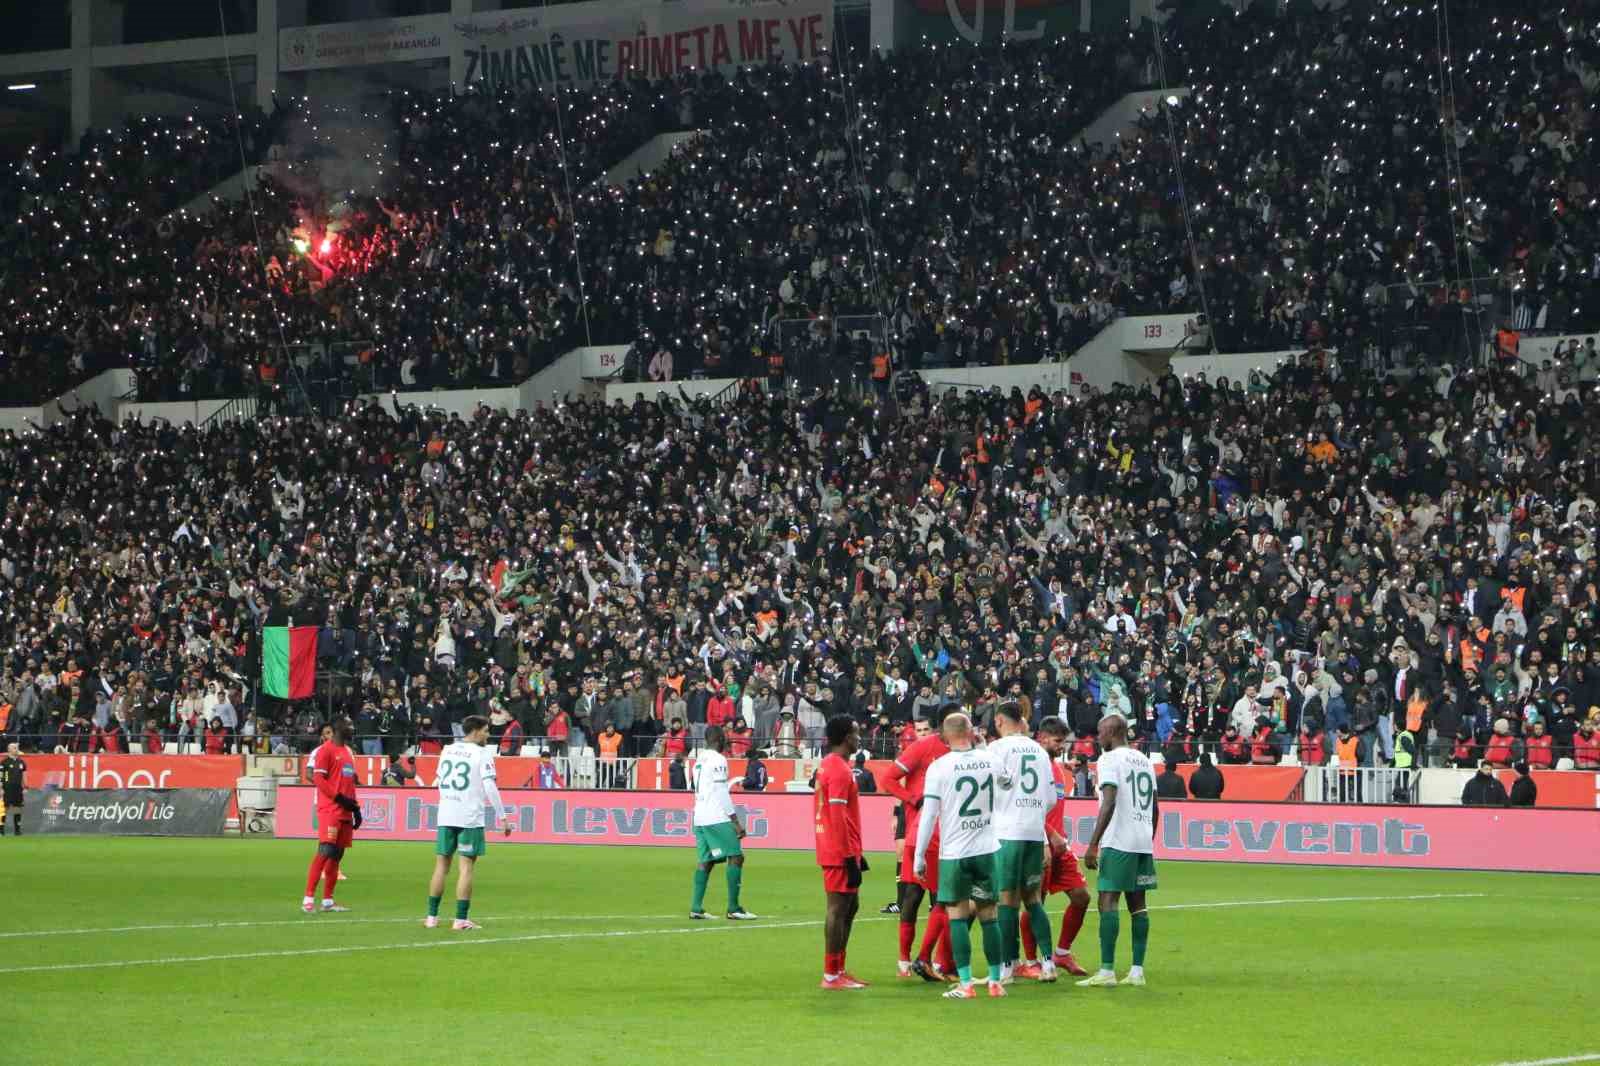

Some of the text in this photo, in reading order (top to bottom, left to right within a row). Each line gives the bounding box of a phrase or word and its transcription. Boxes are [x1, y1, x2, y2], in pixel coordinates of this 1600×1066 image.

[574, 38, 612, 80] ME
[737, 18, 780, 62] ME
[1144, 324, 1162, 338] 133
[600, 353, 616, 367] 134
[440, 759, 471, 791] 23
[1020, 754, 1039, 794] 5
[1126, 769, 1153, 811] 19
[68, 801, 145, 824] trendyol
[955, 772, 994, 818] 21
[551, 799, 769, 838] levet
[1162, 811, 1430, 856] levent
